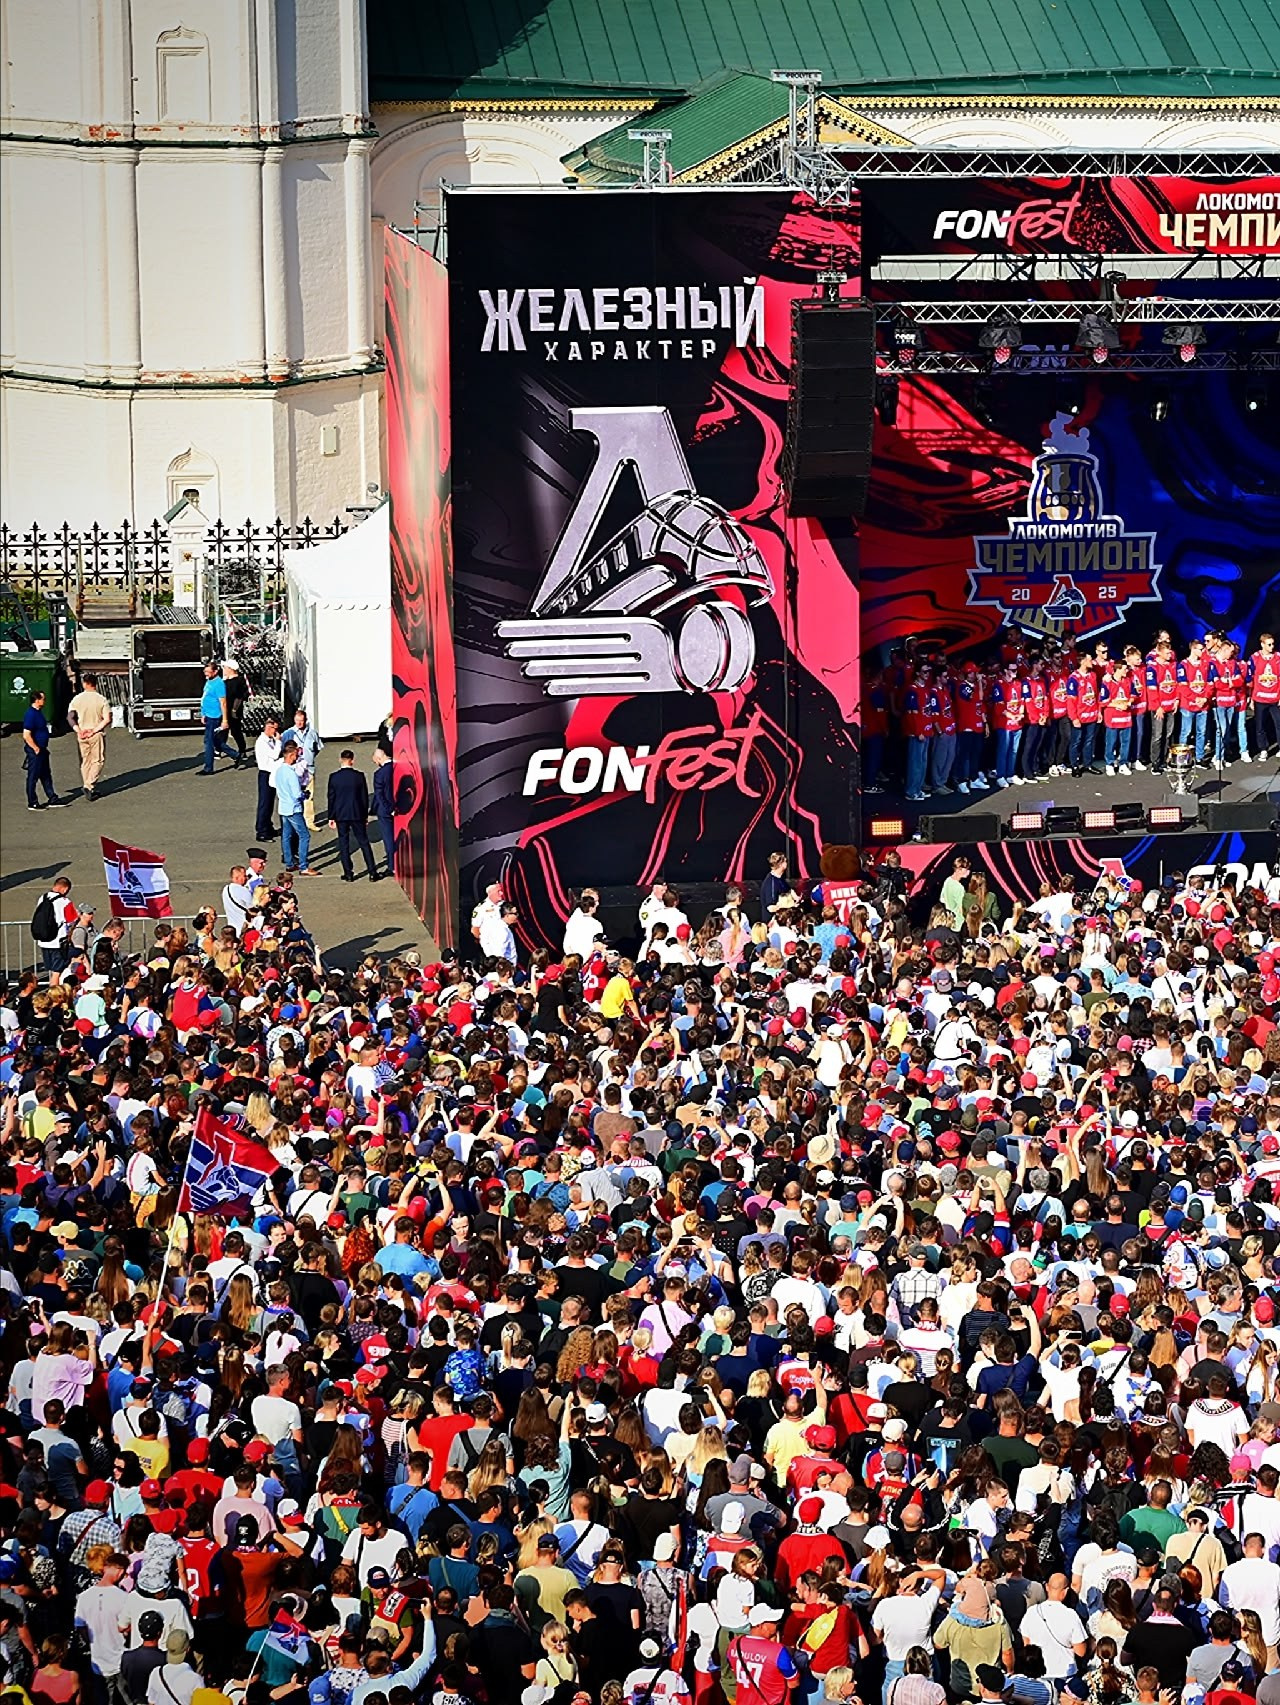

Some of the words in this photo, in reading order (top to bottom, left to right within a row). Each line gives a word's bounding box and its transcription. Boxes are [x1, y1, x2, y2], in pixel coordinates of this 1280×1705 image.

[478, 277, 765, 353] ЖЕЛЕЗНЫЙ
[544, 339, 717, 361] ХАРАКТЕР
[1015, 523, 1118, 540] ЛОКОМОТИВ
[982, 538, 1148, 574] ЧЕМПИОН
[1011, 588, 1031, 602] 20
[1098, 585, 1118, 599] 25
